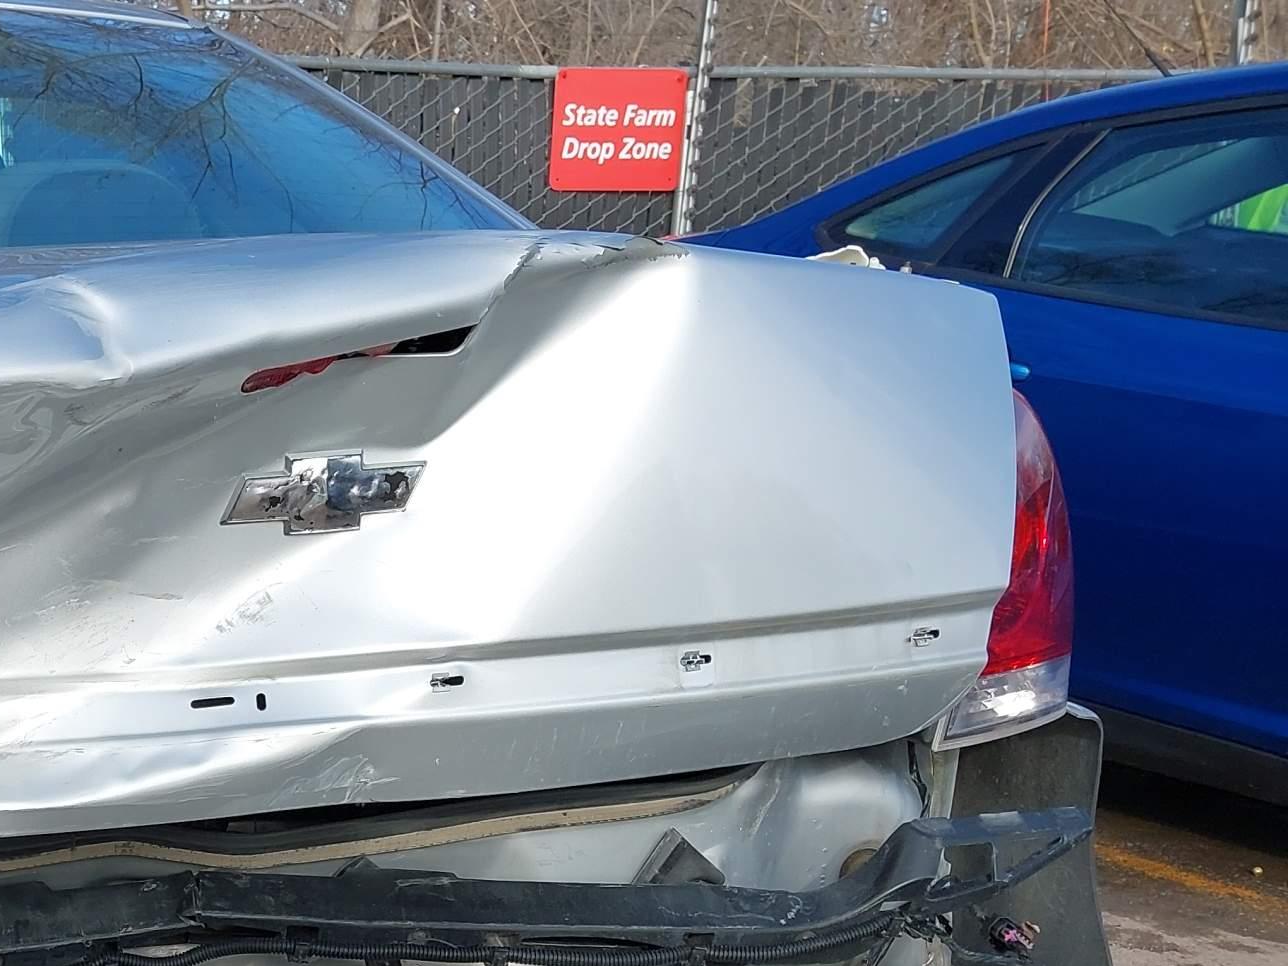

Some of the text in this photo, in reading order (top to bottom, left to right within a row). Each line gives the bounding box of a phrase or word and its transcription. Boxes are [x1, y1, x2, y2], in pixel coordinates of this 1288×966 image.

[562, 103, 676, 127] State Farm
[561, 137, 672, 165] Drop Zone
